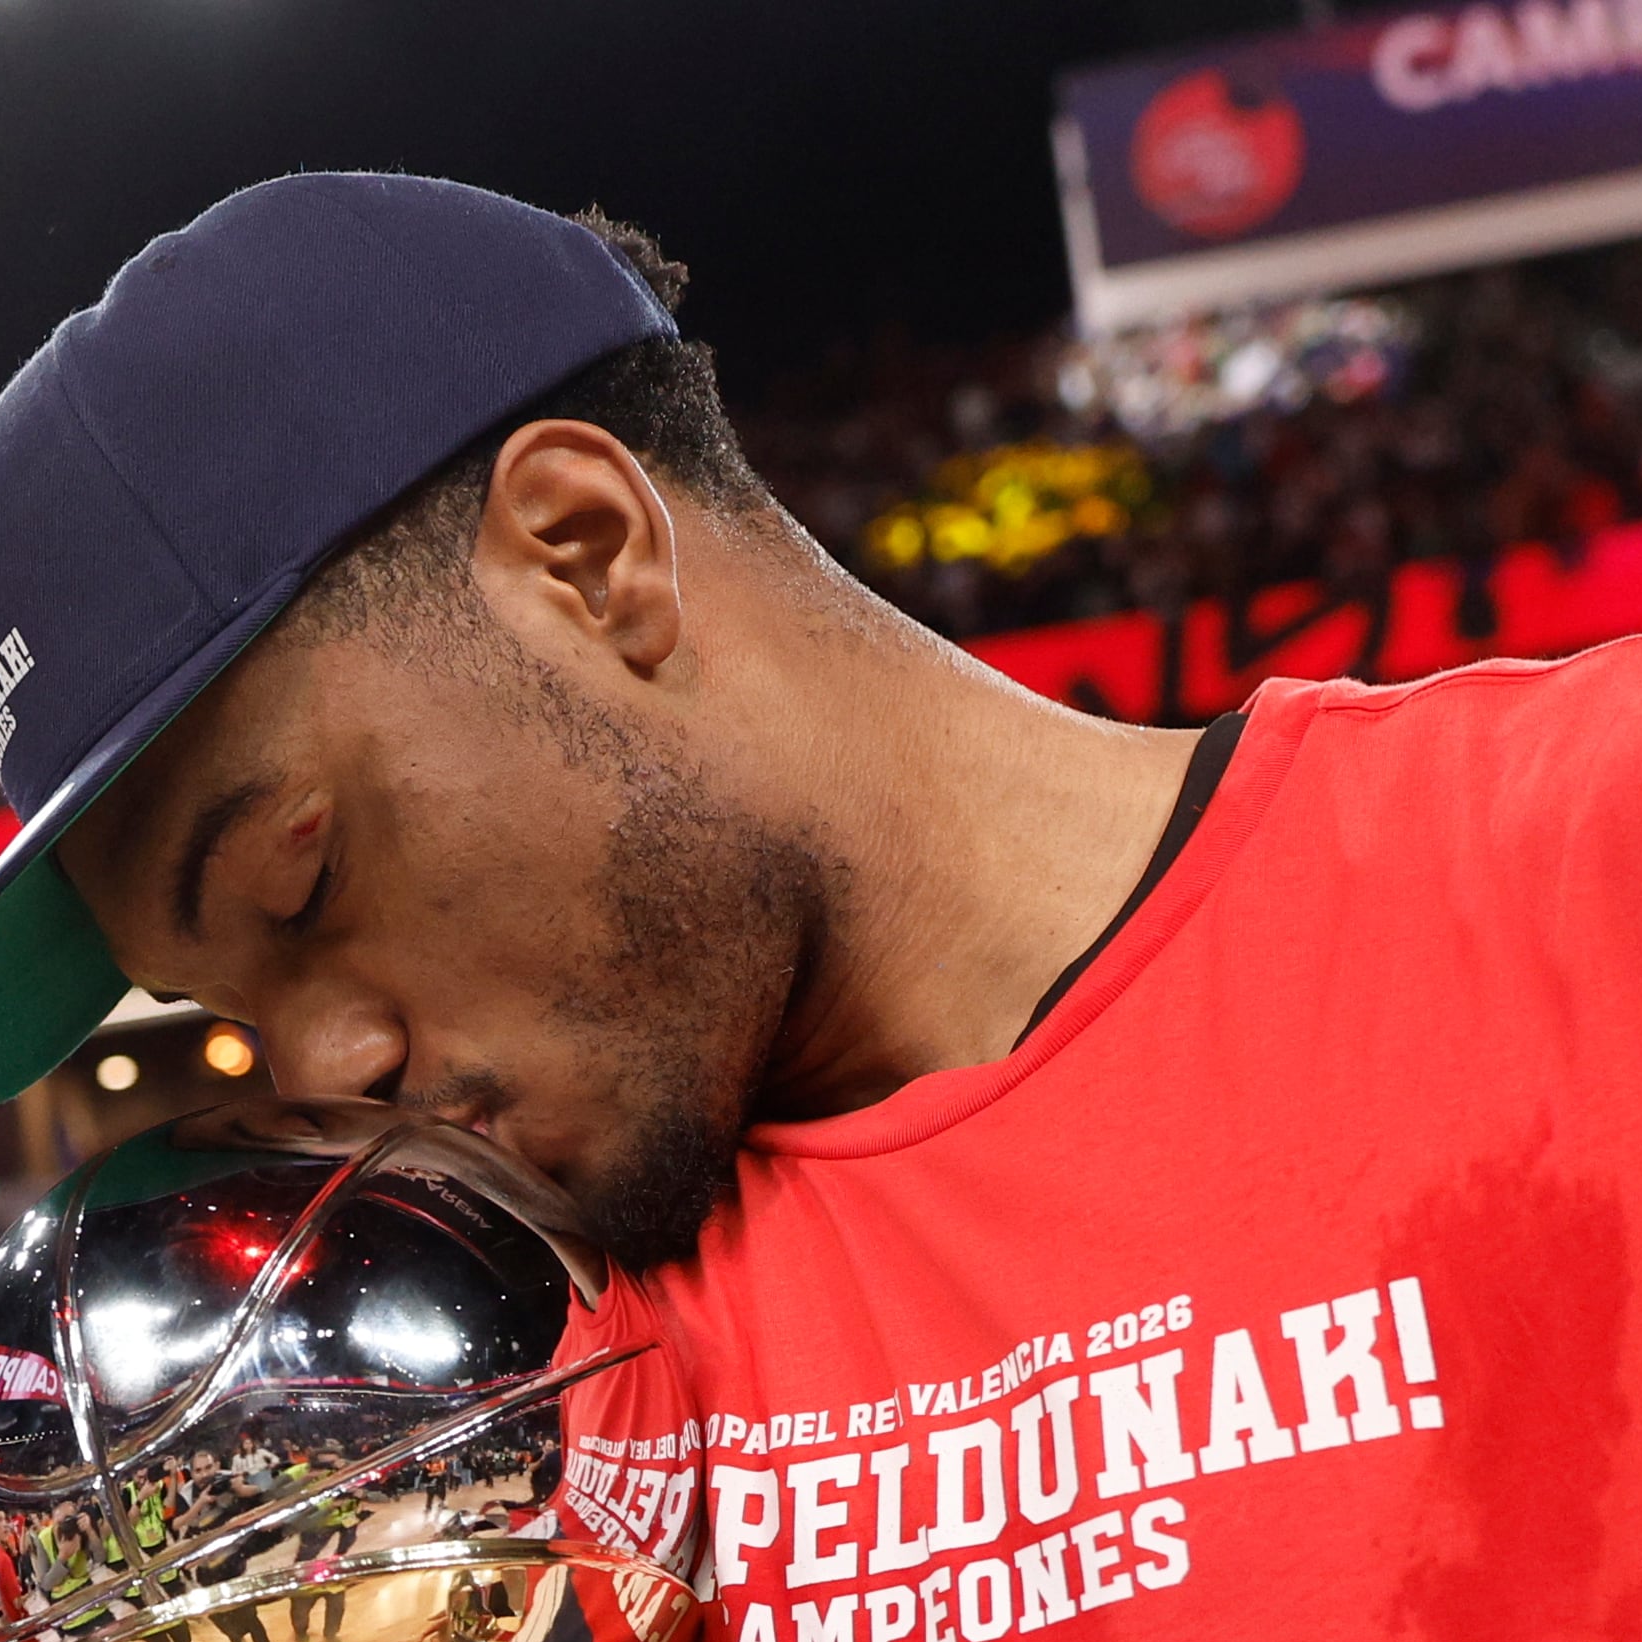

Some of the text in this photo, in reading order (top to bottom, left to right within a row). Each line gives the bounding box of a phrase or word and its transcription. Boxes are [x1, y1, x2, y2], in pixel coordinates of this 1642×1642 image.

[705, 1294, 1194, 1455] OPA DEL RE VALENCIA 2026
[710, 1276, 1445, 1592] PELDUNAK!
